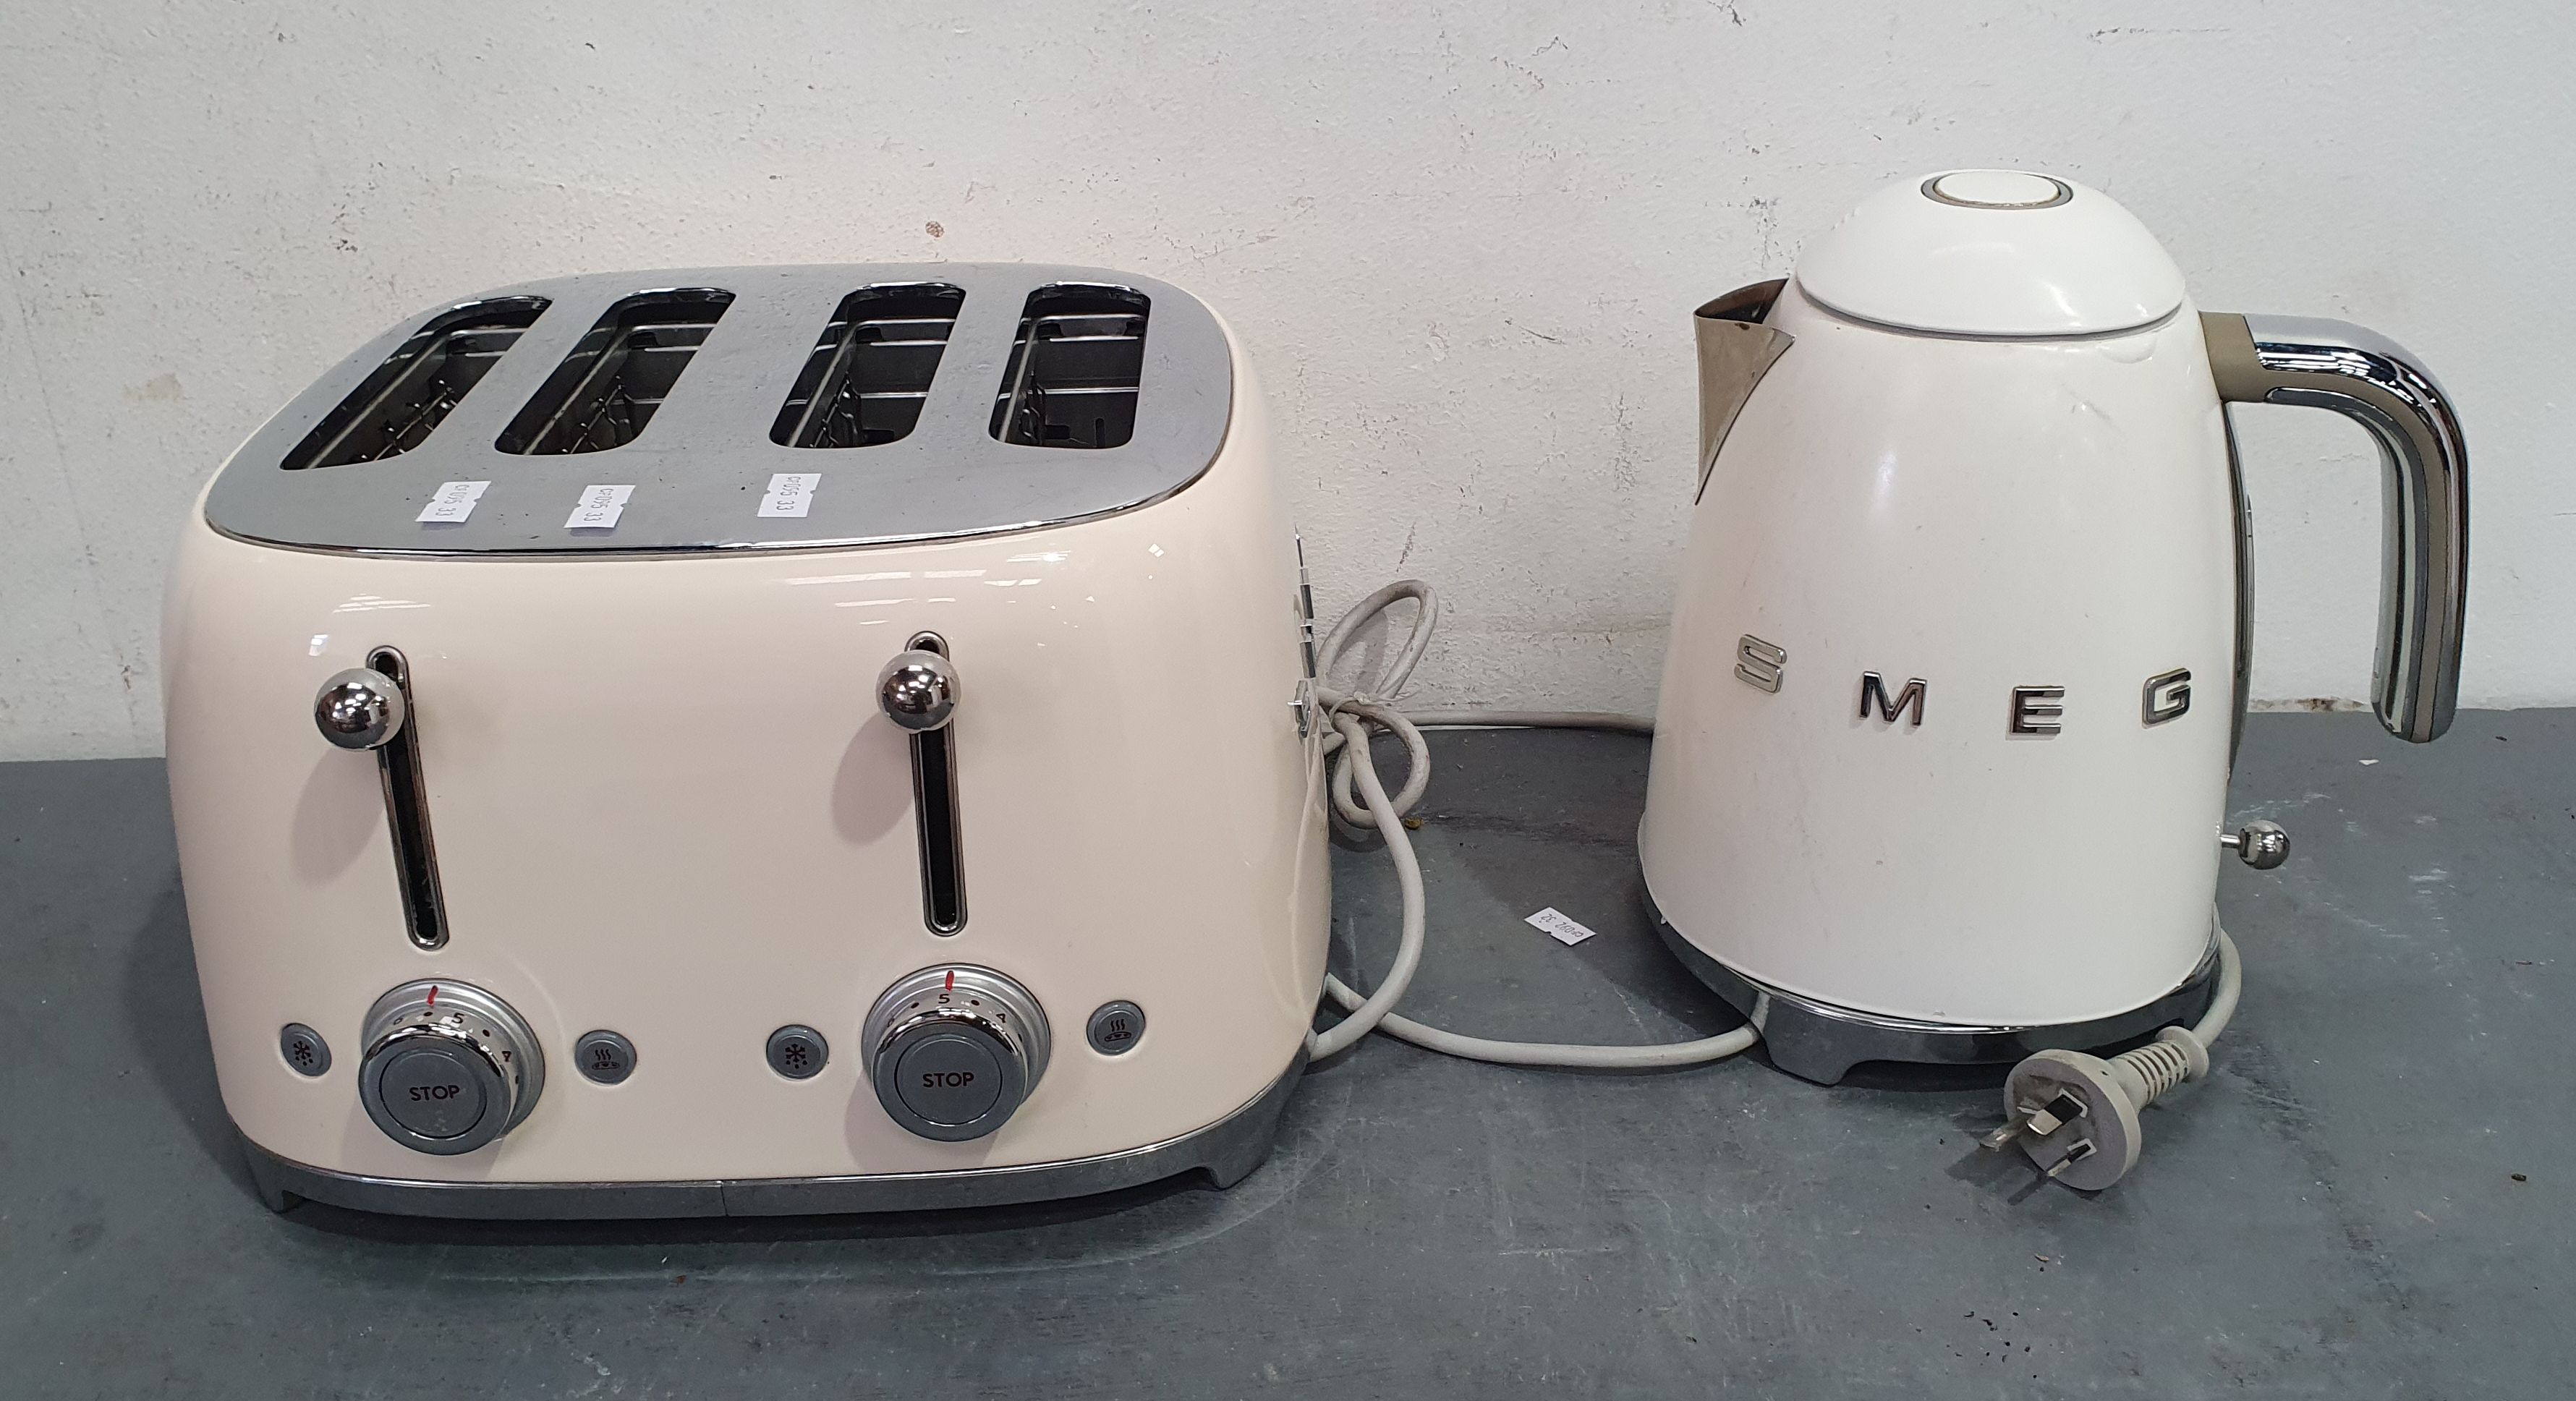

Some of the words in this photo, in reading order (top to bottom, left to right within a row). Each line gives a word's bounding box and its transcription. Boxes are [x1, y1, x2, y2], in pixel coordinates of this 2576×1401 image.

[435, 508, 456, 516] 33
[775, 501, 795, 511] 33
[583, 512, 603, 521] 33
[938, 993, 951, 1005] 5
[995, 1013, 1007, 1024] 4
[451, 1012, 465, 1024] 5
[922, 1072, 974, 1089] STOP
[409, 1084, 460, 1102] STOP
